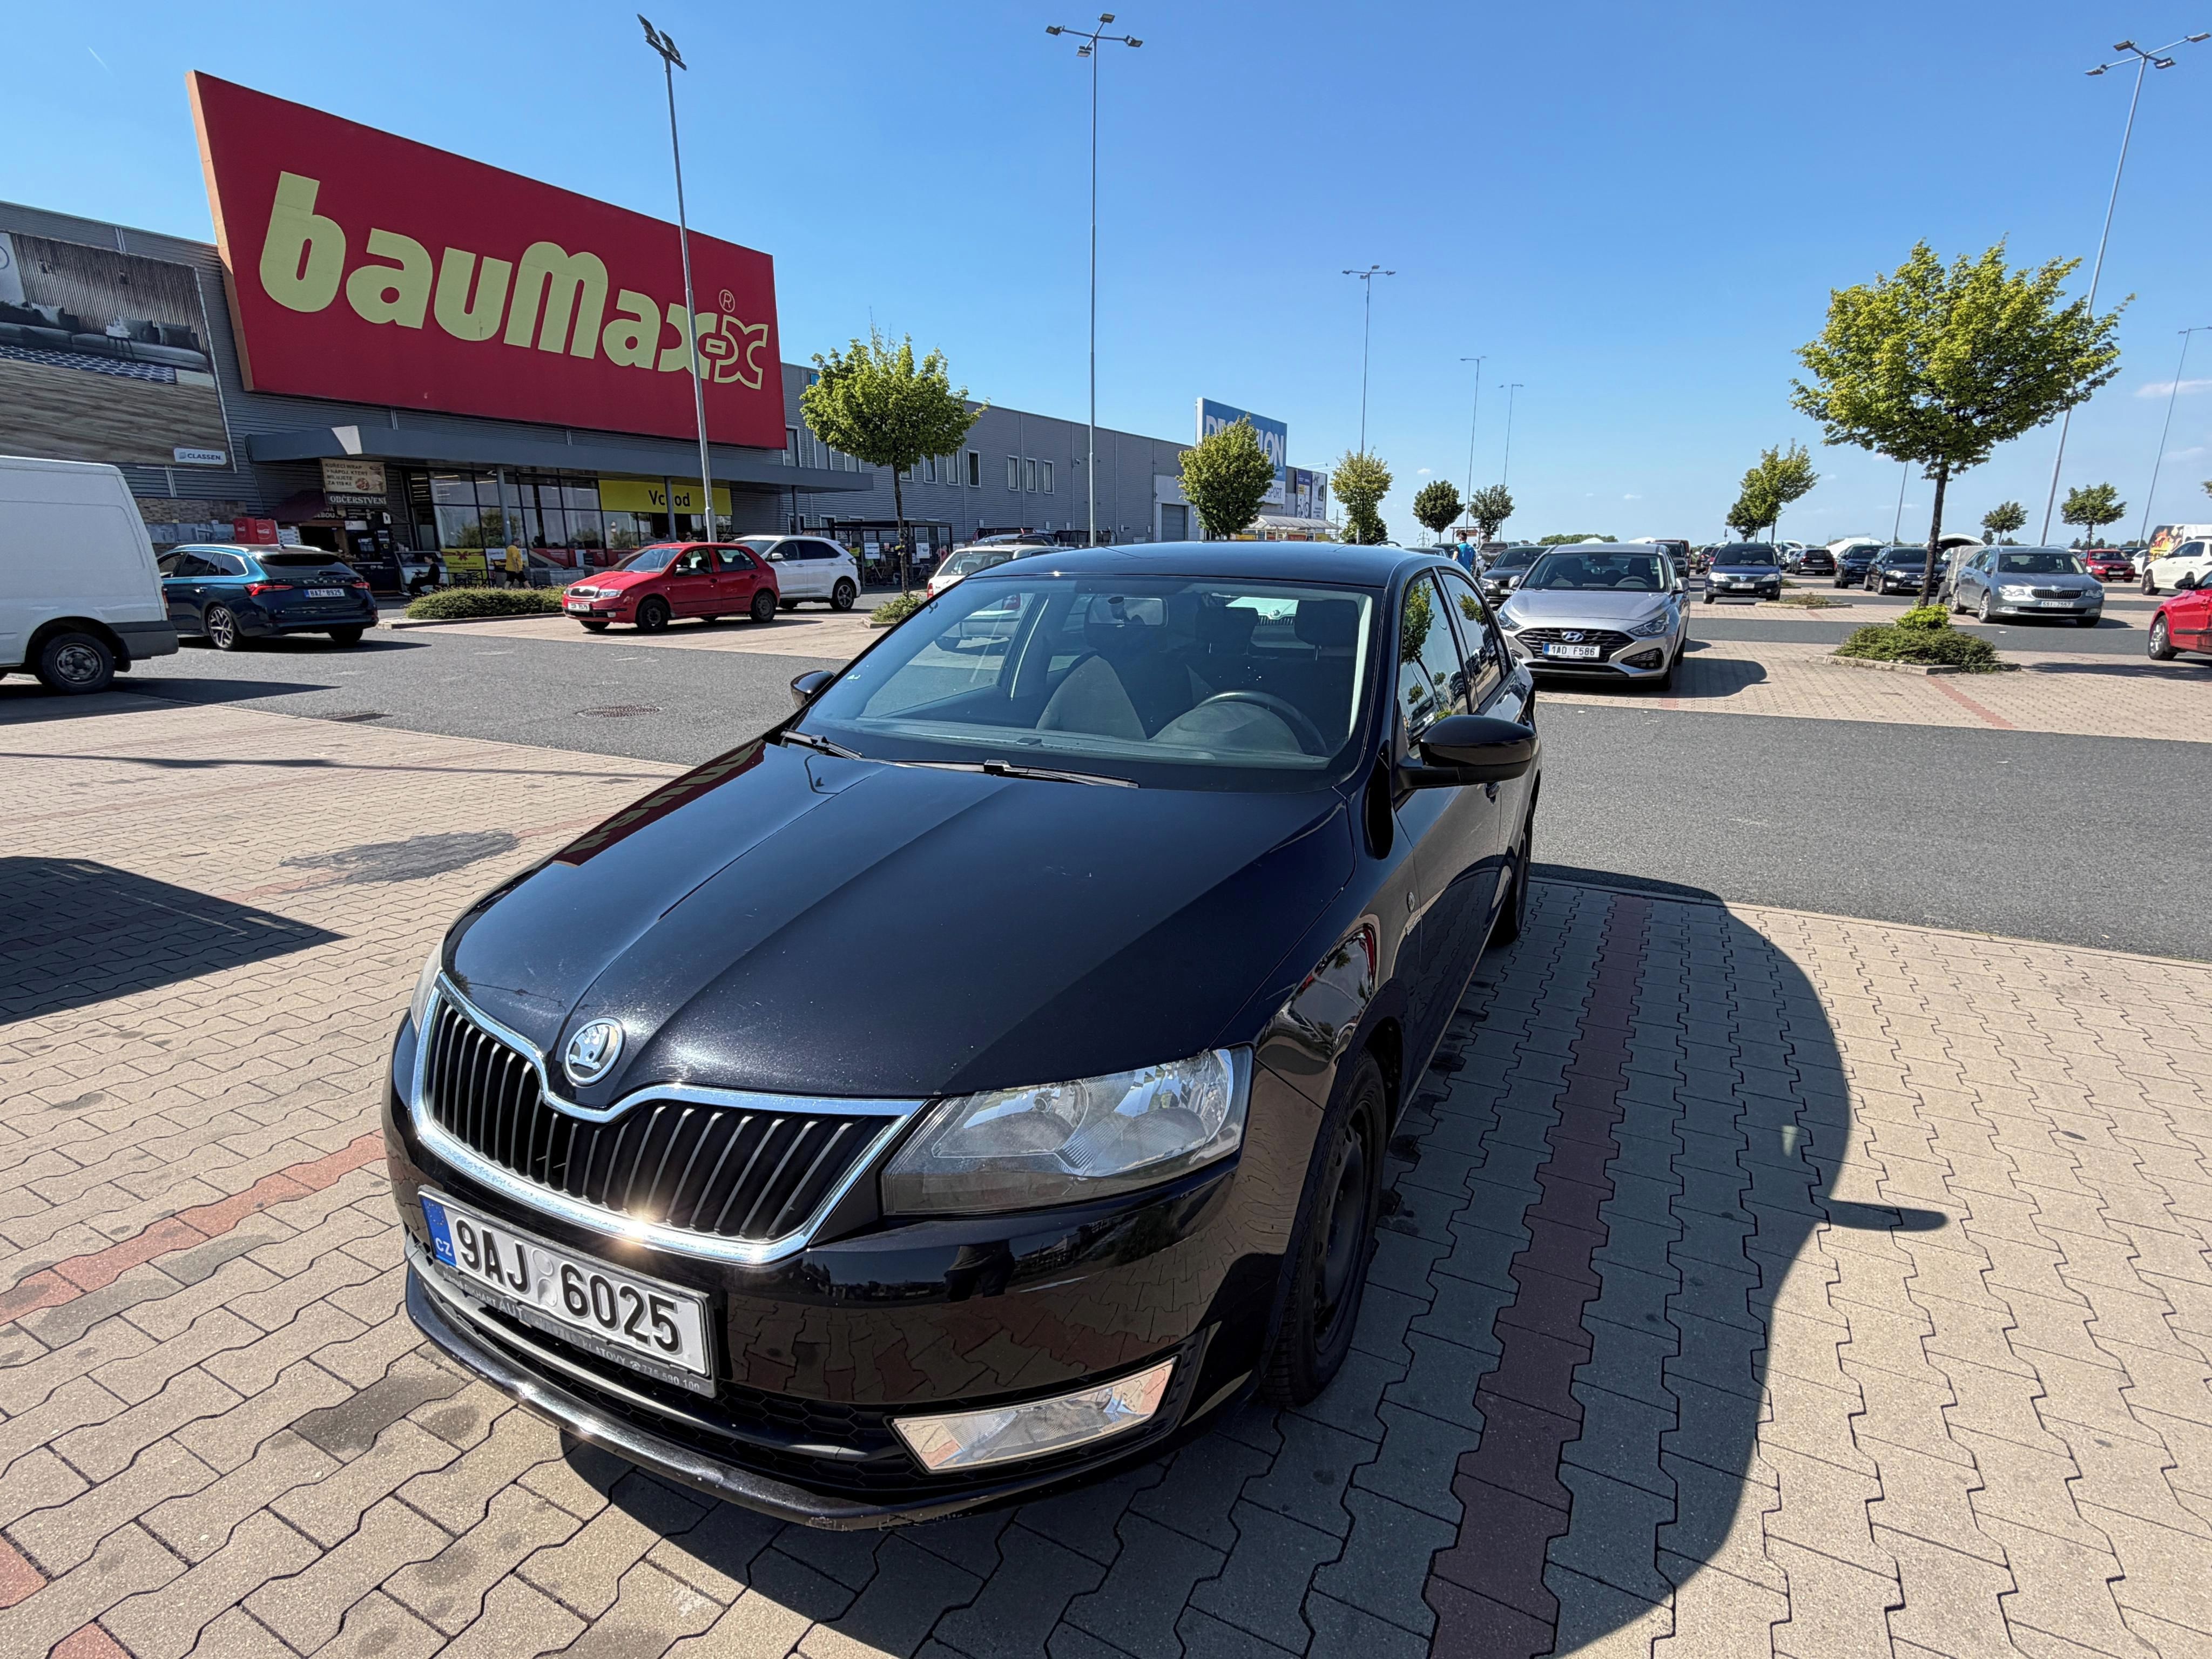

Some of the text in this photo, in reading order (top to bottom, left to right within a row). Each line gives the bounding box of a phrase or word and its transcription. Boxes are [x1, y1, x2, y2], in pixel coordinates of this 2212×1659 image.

[648, 490, 690, 507] Vcod
[1552, 646, 1595, 656] 1AD F586
[435, 1237, 453, 1257] CZ
[457, 1218, 528, 1293] 9AJ
[560, 1263, 680, 1352] 6025
[683, 1378, 700, 1391] 100
